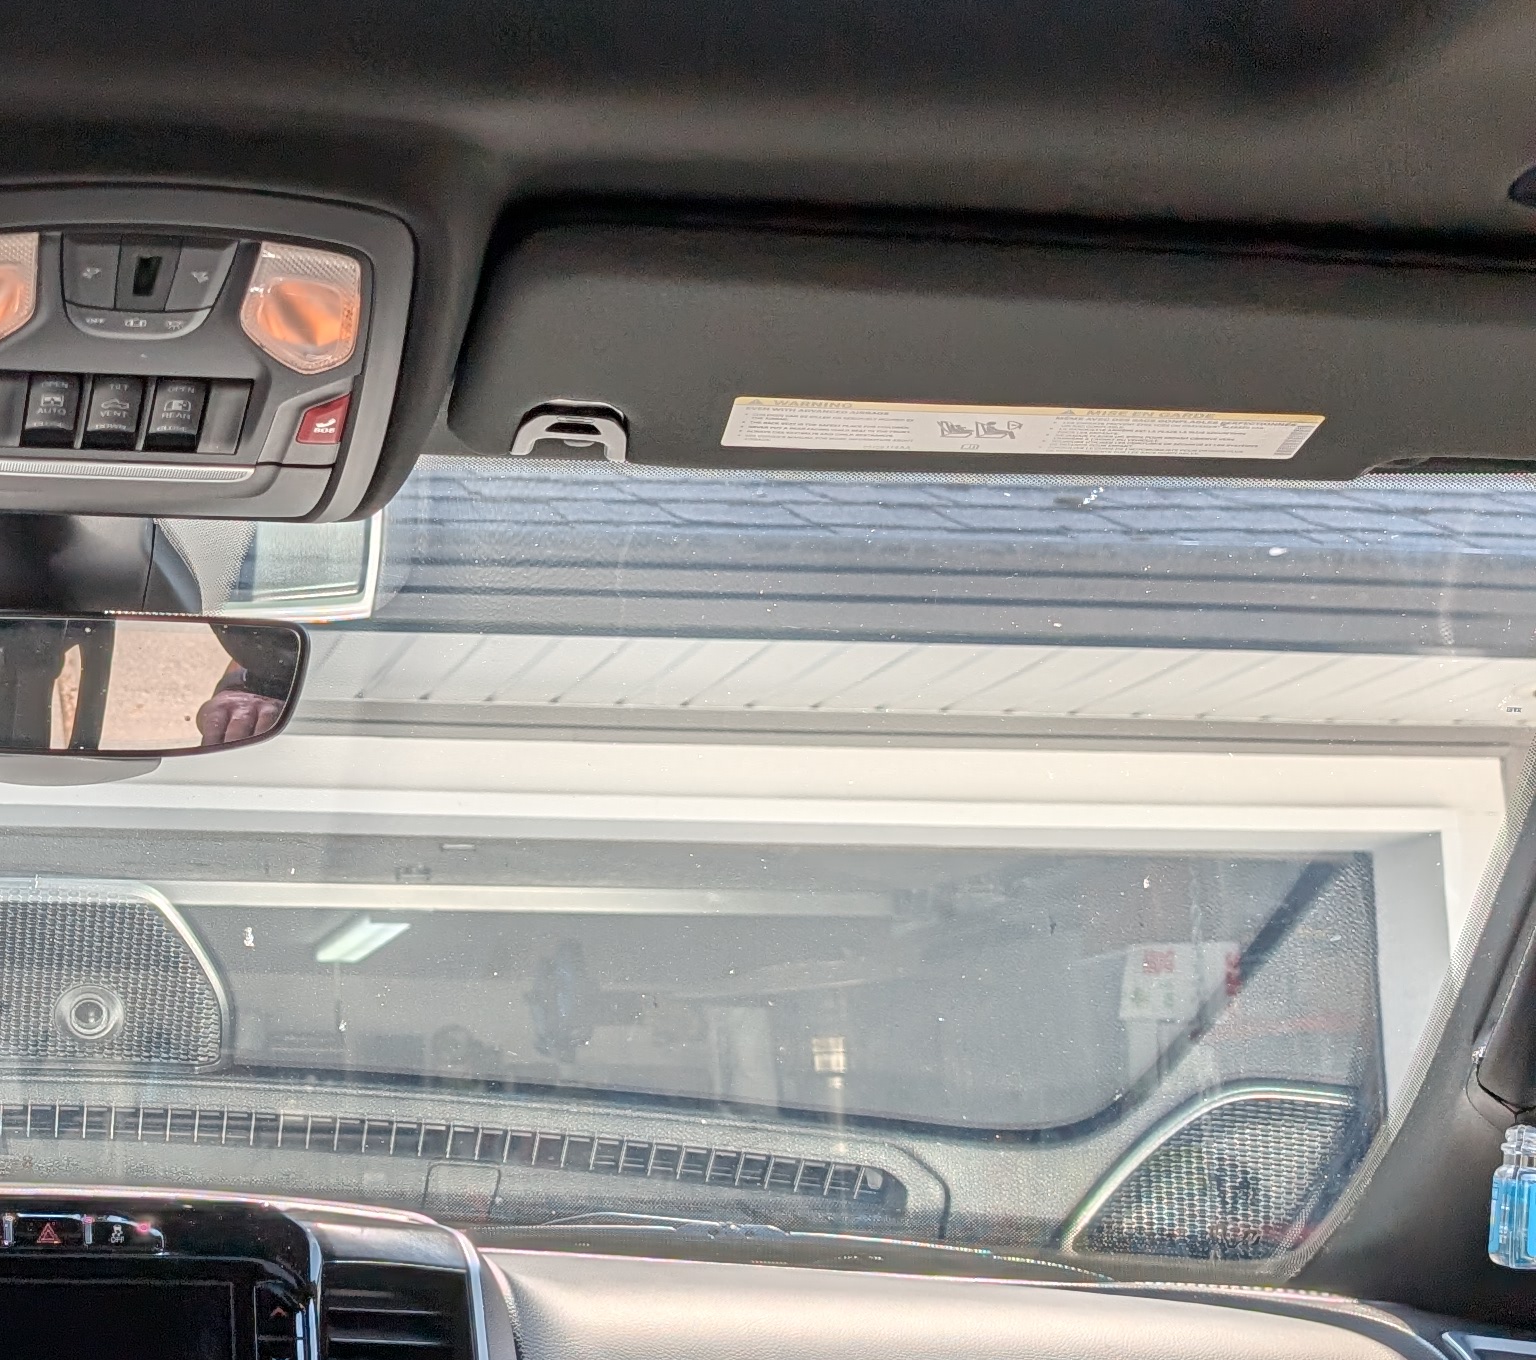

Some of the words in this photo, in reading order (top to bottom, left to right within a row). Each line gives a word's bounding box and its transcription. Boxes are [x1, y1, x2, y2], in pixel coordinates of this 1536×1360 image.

[41, 380, 69, 389] OPEN
[773, 399, 853, 409] WARNING
[36, 406, 67, 416] AUTO
[99, 410, 128, 418] VENT
[1086, 409, 1135, 417] MISE
[1137, 410, 1157, 418] EN
[1159, 411, 1216, 419] GARDE
[161, 412, 191, 420] REAR
